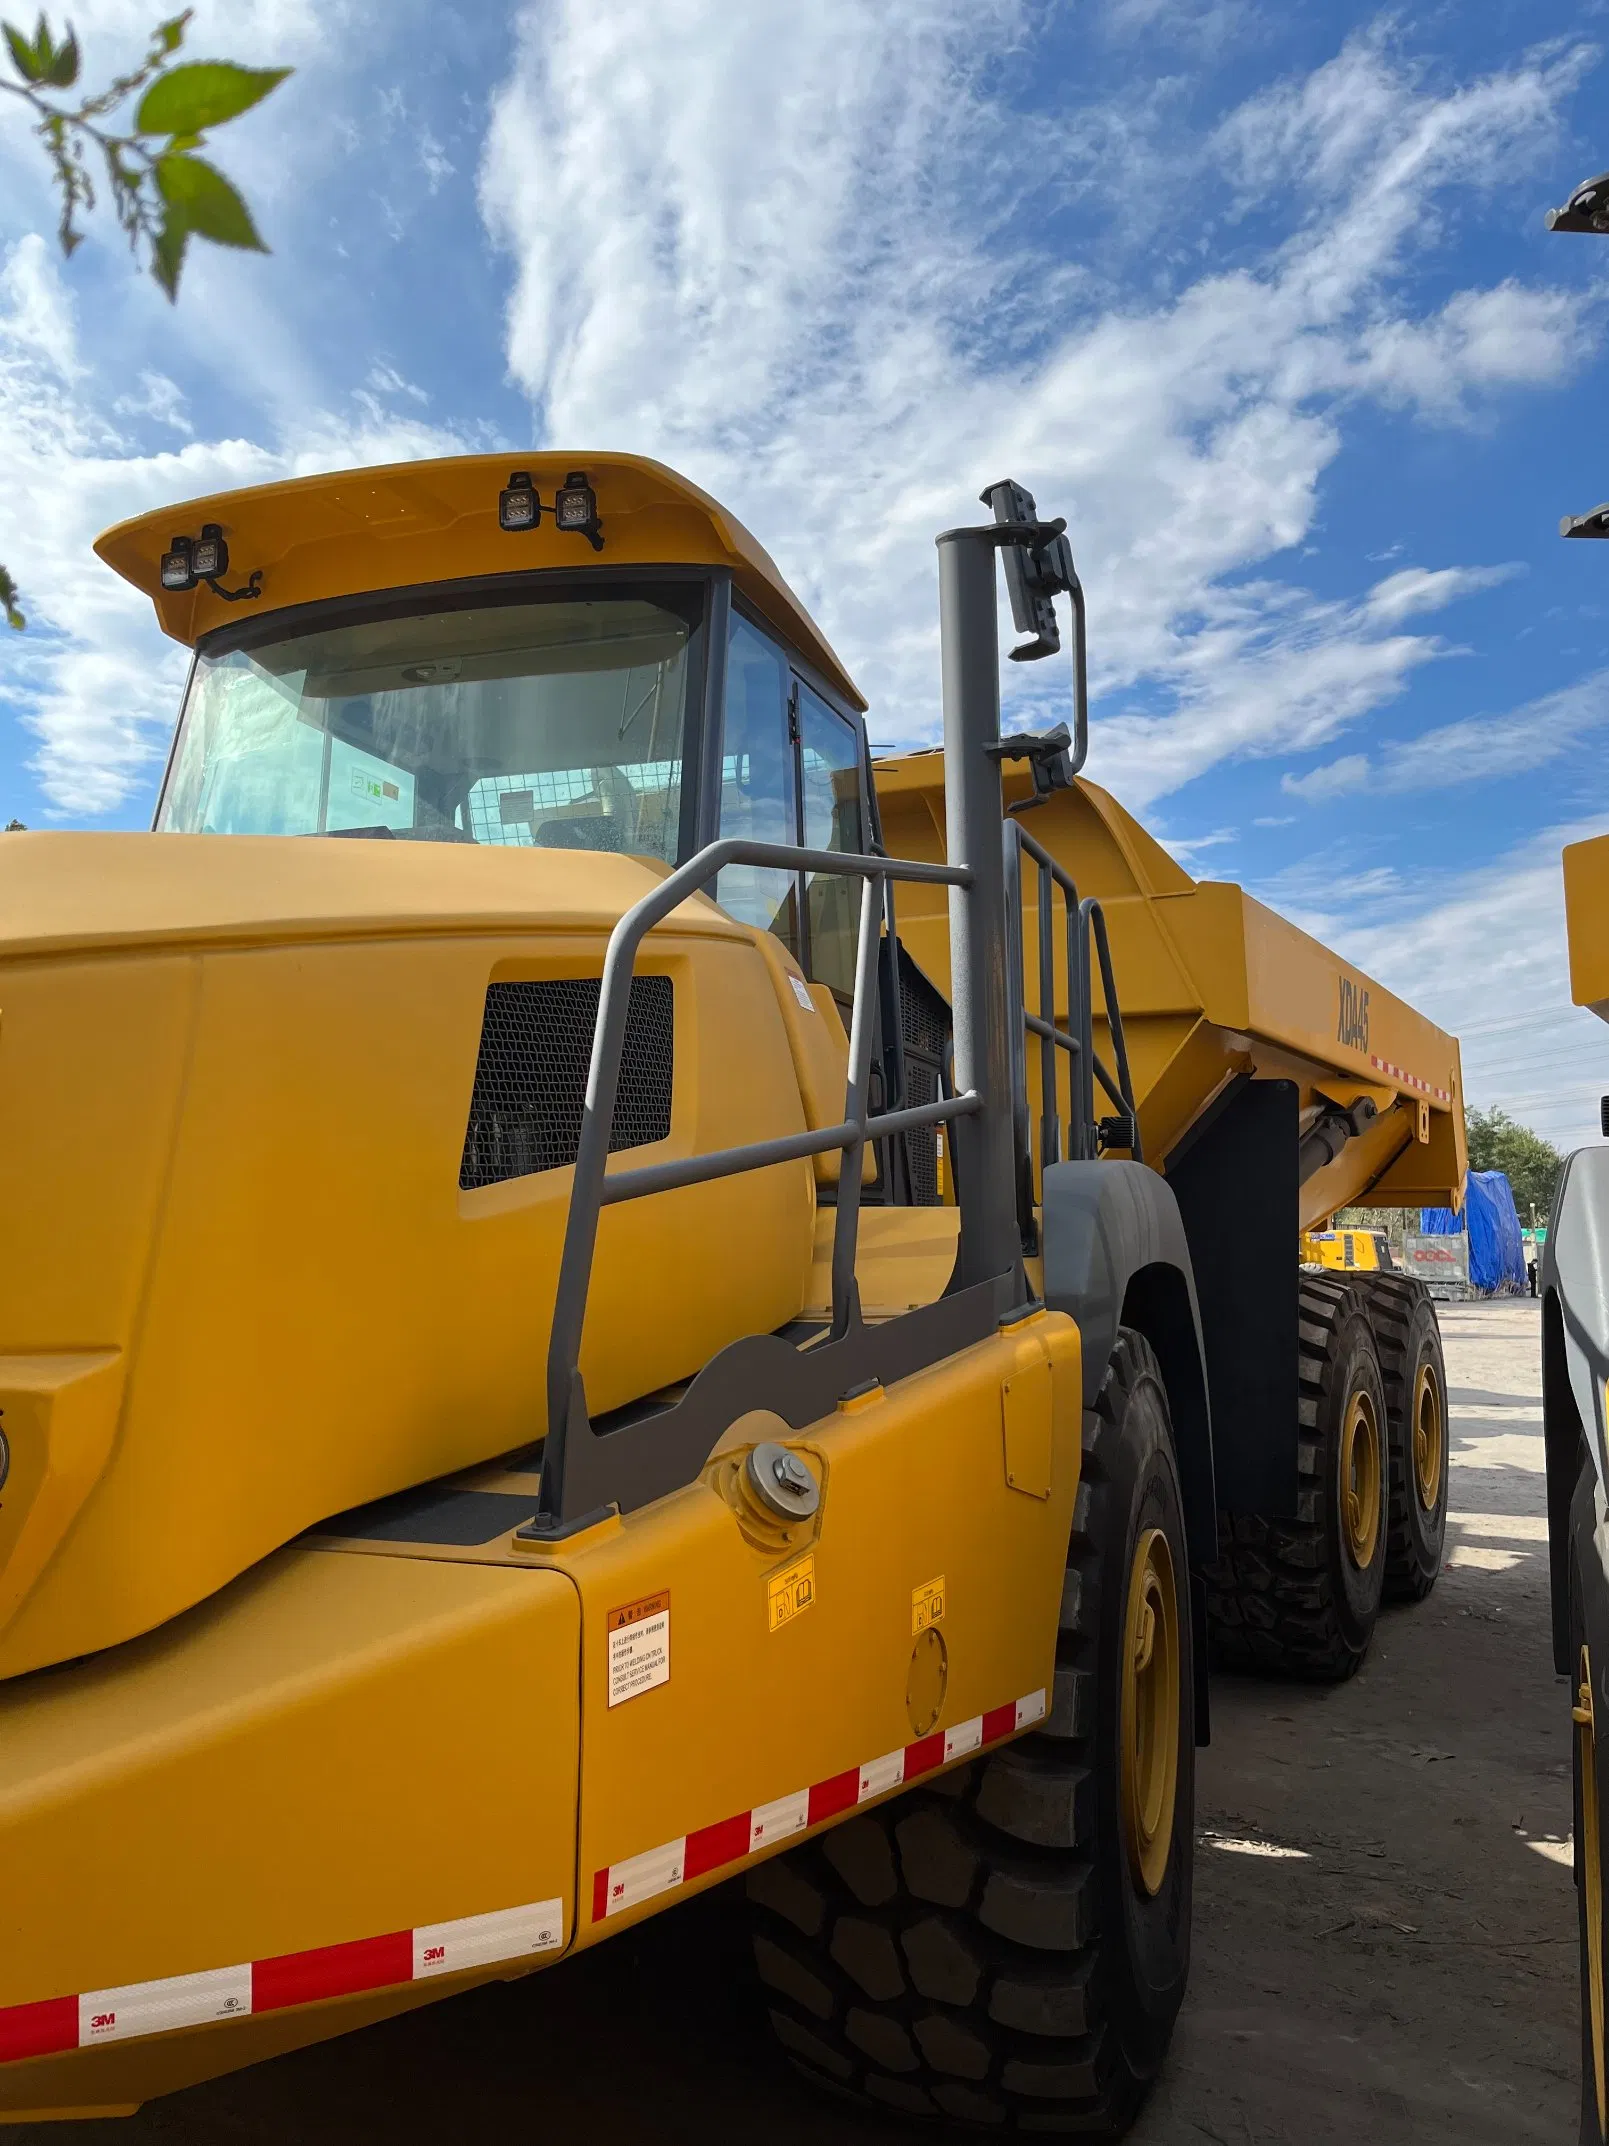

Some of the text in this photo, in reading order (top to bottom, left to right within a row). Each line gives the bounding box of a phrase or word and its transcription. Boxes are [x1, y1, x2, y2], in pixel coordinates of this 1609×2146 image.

[1337, 975, 1369, 1055] XDA45
[754, 1824, 763, 1837] 3M
[612, 1883, 625, 1898] 3M
[423, 1946, 445, 1961] 3M
[91, 2012, 116, 2028] 3M
